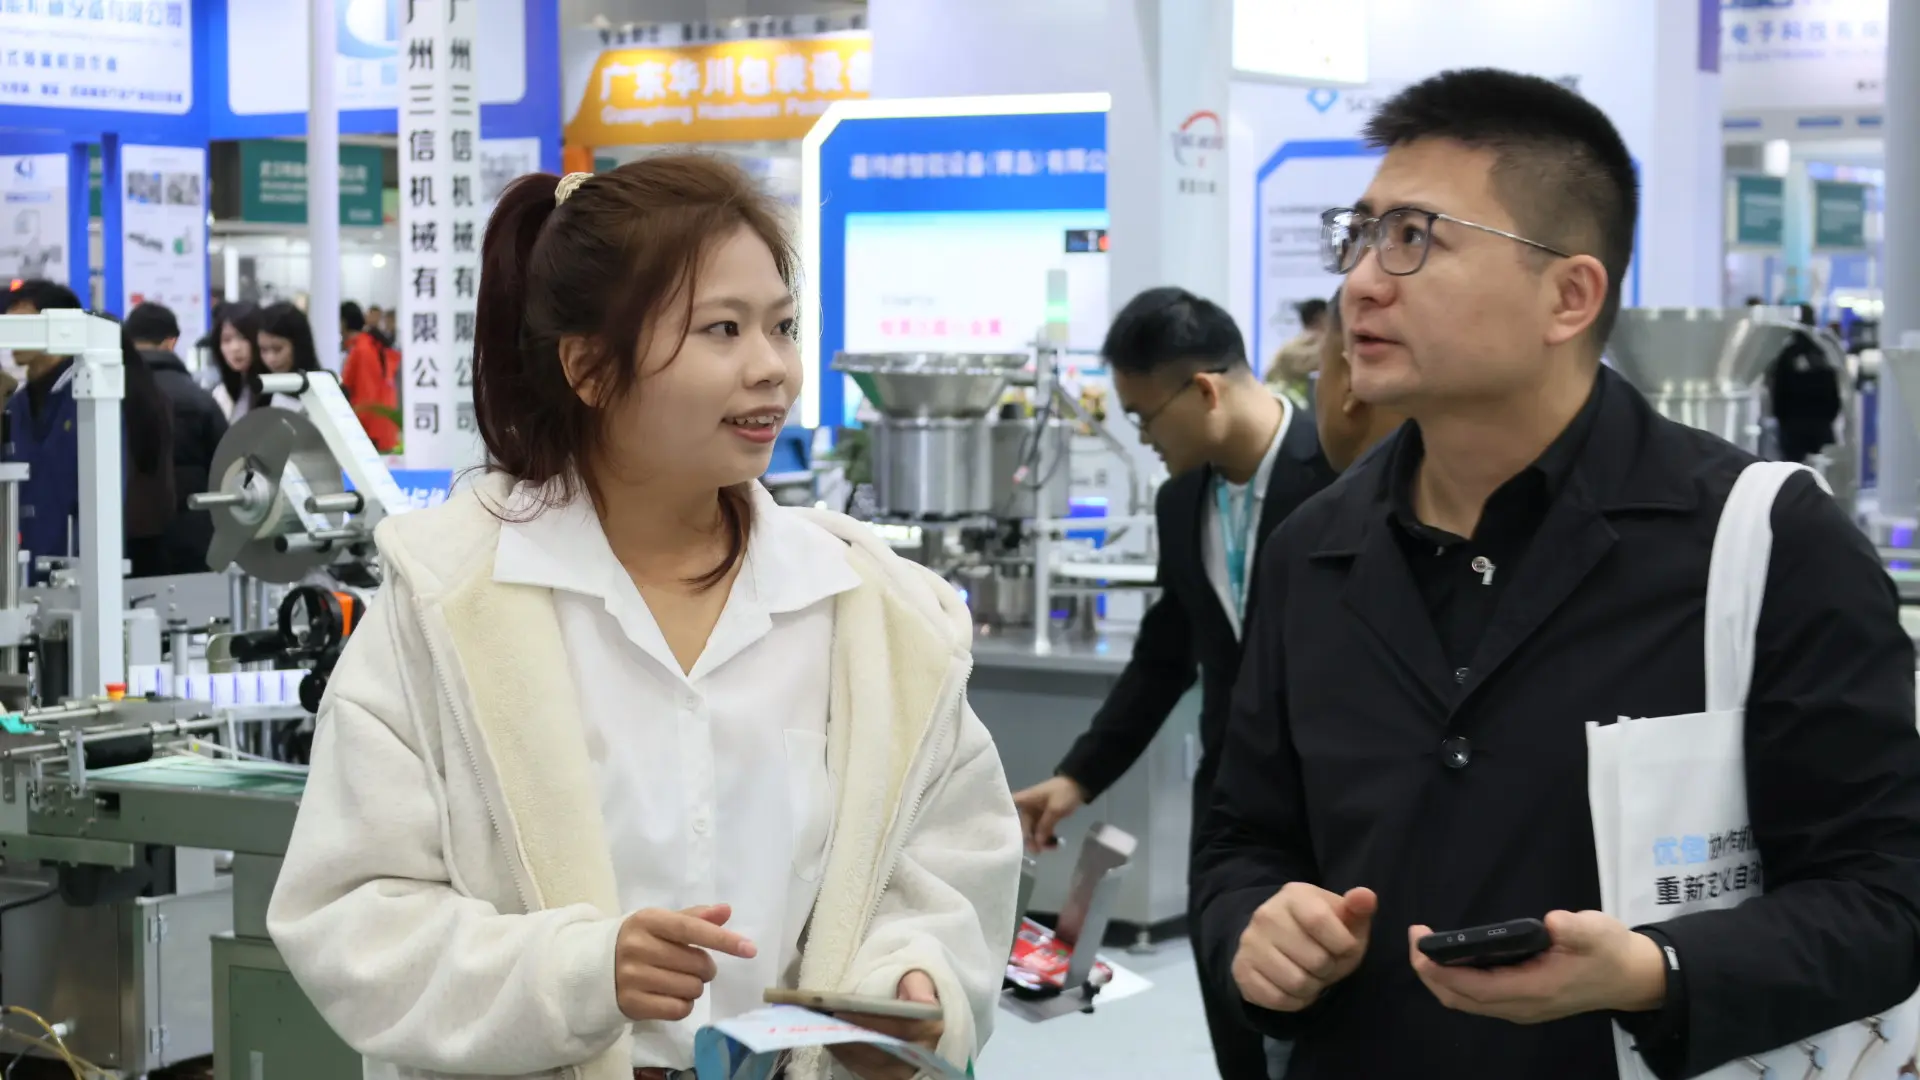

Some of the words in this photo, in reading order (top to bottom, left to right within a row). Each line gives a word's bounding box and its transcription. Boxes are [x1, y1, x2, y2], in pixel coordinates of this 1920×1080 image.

[406, 0, 440, 434] 广州三信机械有限公司
